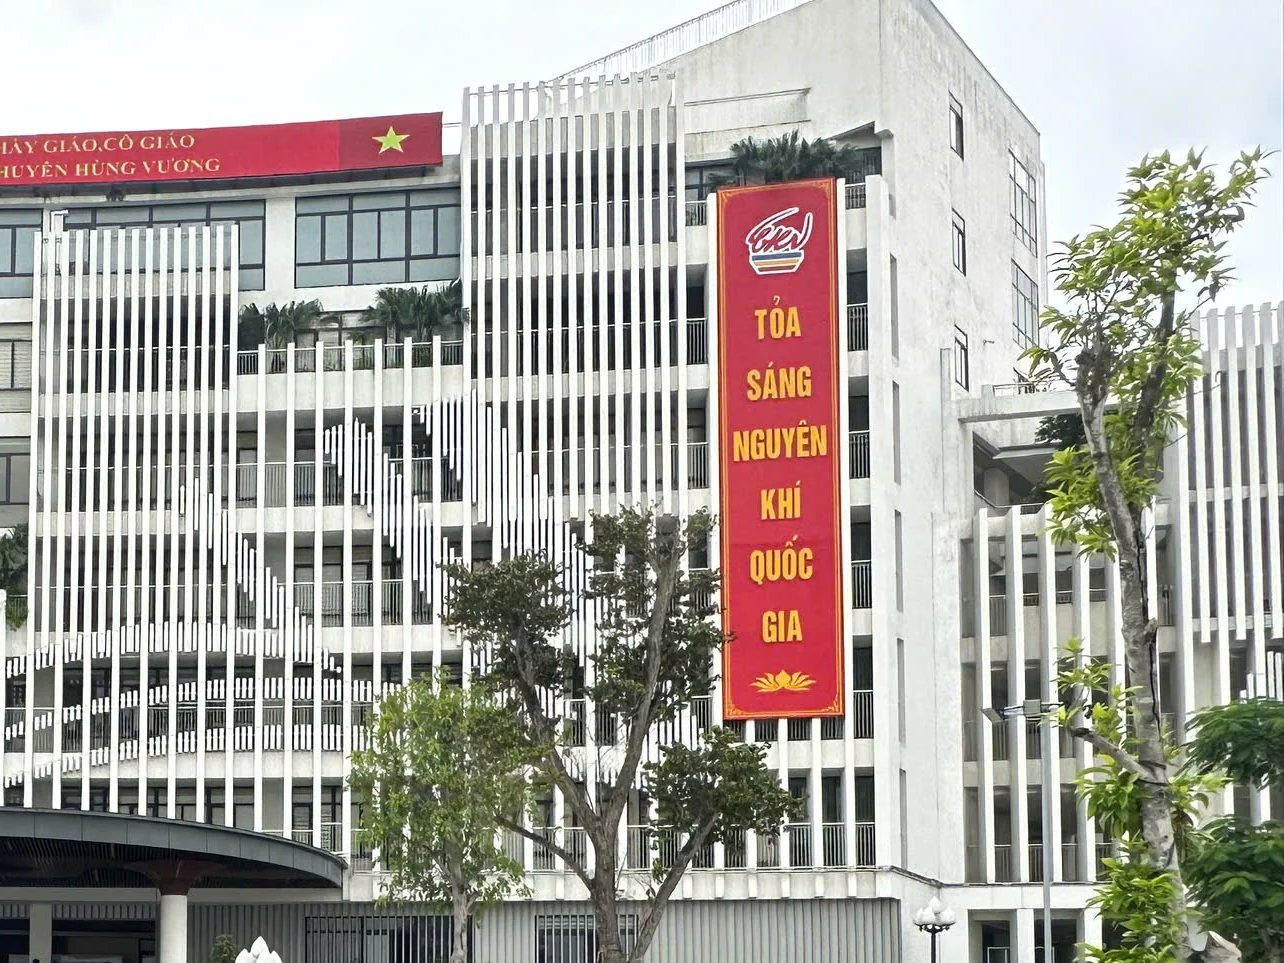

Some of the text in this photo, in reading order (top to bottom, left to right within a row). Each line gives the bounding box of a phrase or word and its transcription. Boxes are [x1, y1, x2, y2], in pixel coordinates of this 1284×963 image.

[140, 131, 195, 150] GIÁO
[75, 159, 136, 177] HÙNG
[143, 157, 220, 174] VƯƠNG
[754, 296, 802, 340] TỎA
[746, 361, 812, 401] SÁNG
[733, 419, 827, 462] NGUYÊN
[760, 480, 801, 520] KHÍ
[749, 534, 814, 585] QUỐC
[762, 609, 803, 643] GIA
